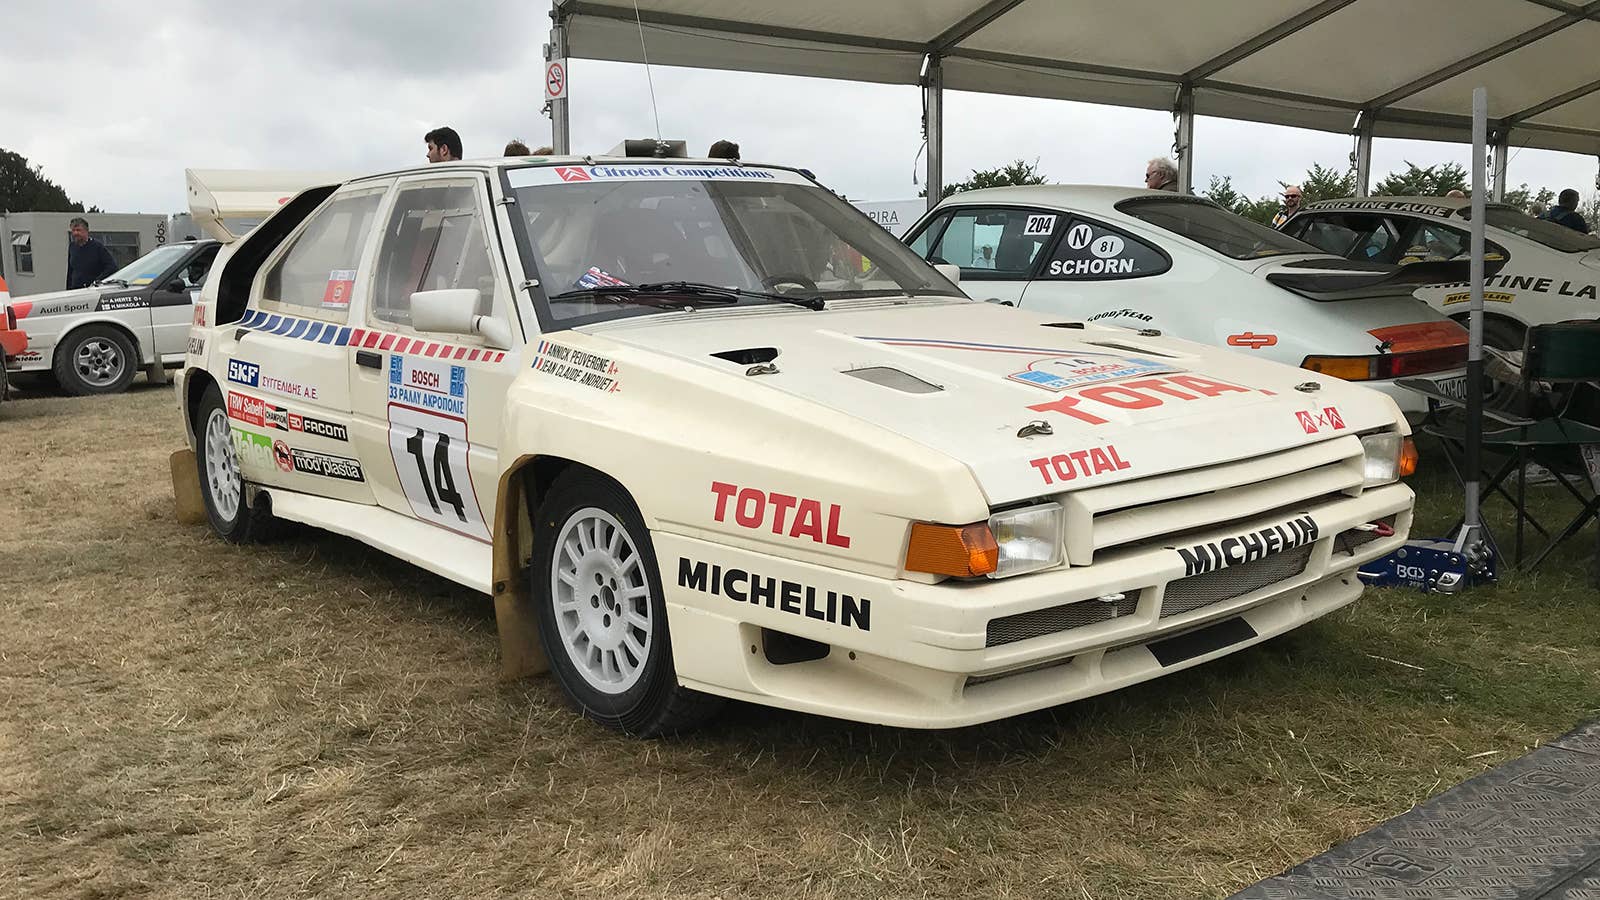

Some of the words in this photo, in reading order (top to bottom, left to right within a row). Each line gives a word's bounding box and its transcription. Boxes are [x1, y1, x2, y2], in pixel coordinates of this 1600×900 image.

[590, 166, 661, 178] Citroën
[662, 166, 775, 181] Compétitions
[1389, 201, 1445, 217] LAURE
[1028, 216, 1053, 234] 204
[1072, 227, 1089, 247] N
[1049, 259, 1135, 275] SCHORN
[1447, 293, 1511, 304] MICELIN
[40, 305, 62, 314] Audi
[64, 303, 89, 313] Sport
[546, 343, 572, 362] ANNICK
[229, 361, 259, 384] SKF
[540, 359, 559, 375] JEAN
[555, 364, 583, 382] CLAUDE
[1054, 358, 1097, 368] 14
[411, 369, 440, 388] BOSCH
[229, 392, 244, 411] TRW
[389, 386, 398, 399] 33
[1025, 375, 1278, 426] TOTA
[265, 409, 288, 424] CHAMPION
[1029, 444, 1132, 485] TOTAL
[406, 427, 469, 524] 14
[711, 481, 851, 550] TOTAL
[1177, 515, 1319, 577] MICHELIN
[1396, 564, 1425, 579] BGS
[677, 556, 871, 632] MICHELIN
